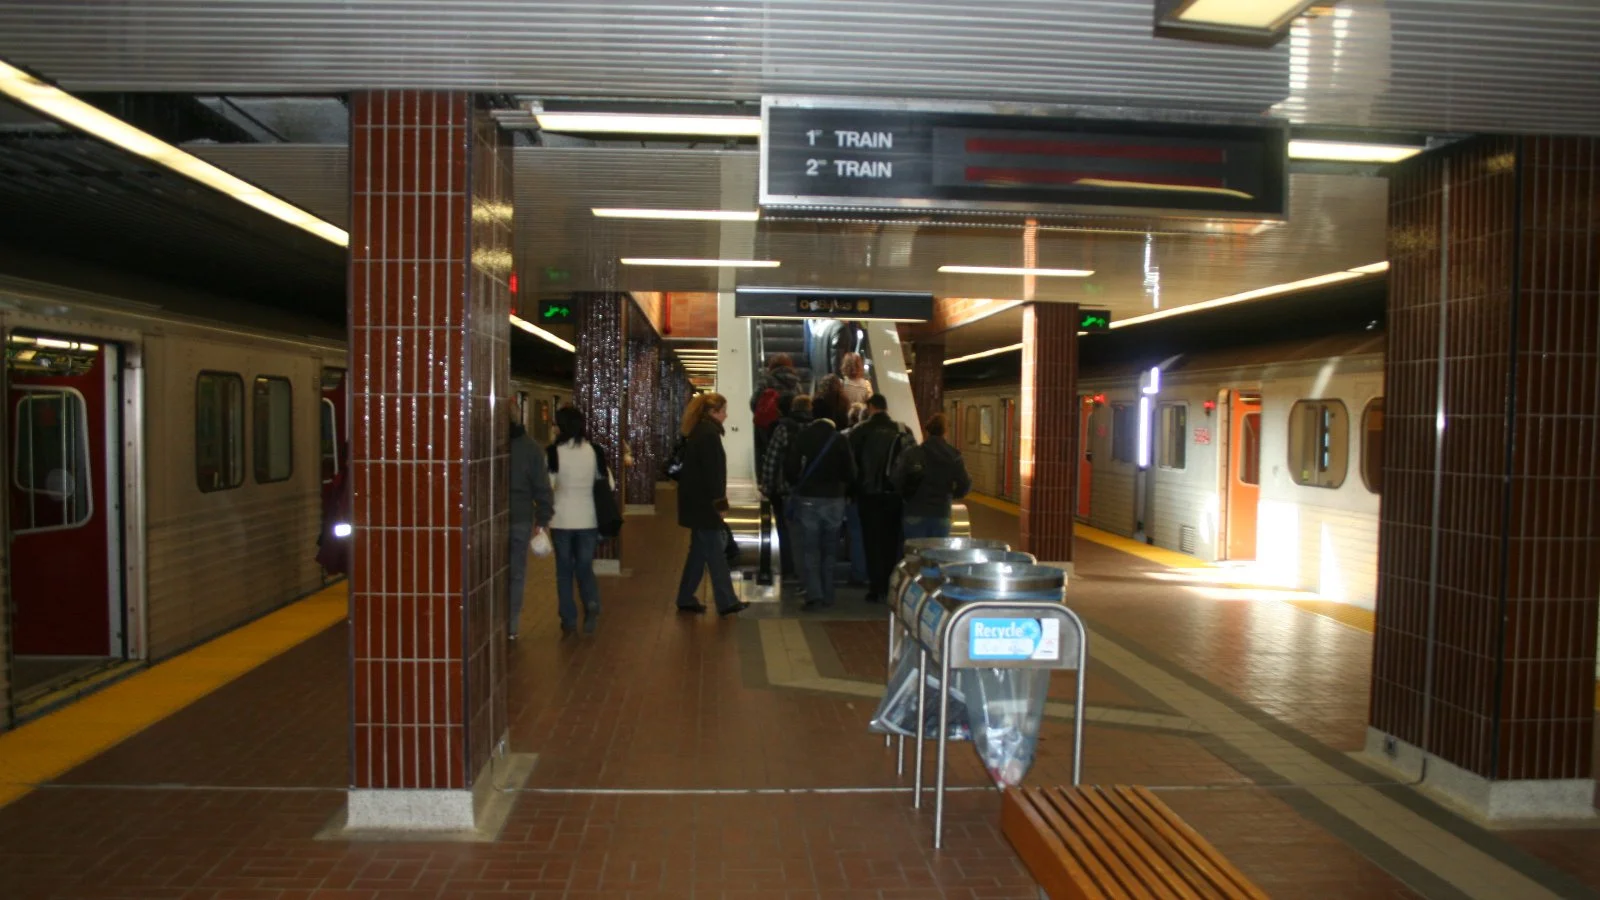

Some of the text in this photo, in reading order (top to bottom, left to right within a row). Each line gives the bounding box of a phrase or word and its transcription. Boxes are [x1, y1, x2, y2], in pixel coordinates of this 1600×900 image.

[834, 130, 893, 149] TRAIN
[833, 159, 893, 178] TRAIN
[974, 621, 1025, 639] Recycle
